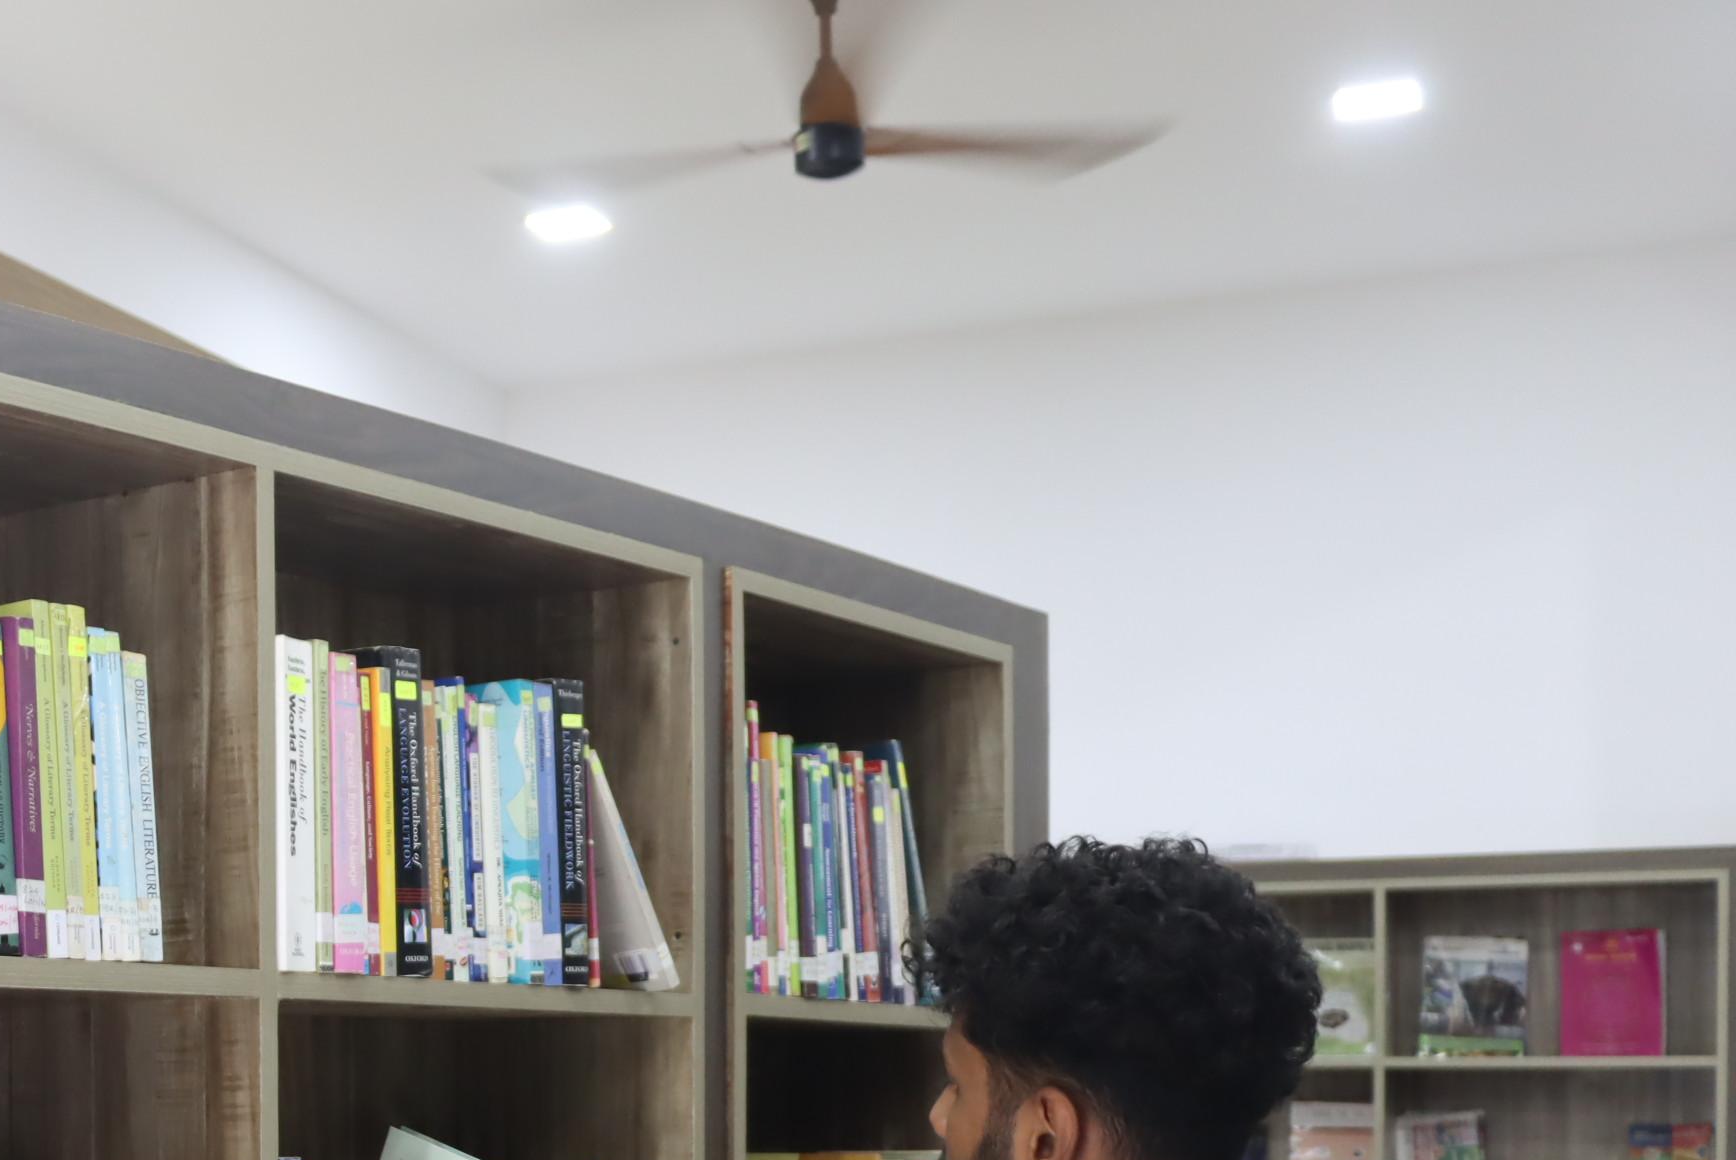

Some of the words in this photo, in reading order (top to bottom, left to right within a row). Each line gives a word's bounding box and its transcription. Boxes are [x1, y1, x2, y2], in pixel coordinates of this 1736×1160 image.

[134, 679, 148, 747] OBJECTIVE
[288, 695, 298, 752] World
[398, 707, 408, 783] LANGUAGE
[409, 712, 418, 736] The
[139, 756, 152, 812] ENGLISH
[410, 740, 420, 782] Oxford
[289, 759, 298, 856] Englishes
[401, 788, 412, 869] EVOLUTION
[411, 785, 421, 849] Handbook
[142, 818, 157, 899] LITERATURE
[412, 853, 422, 869] of
